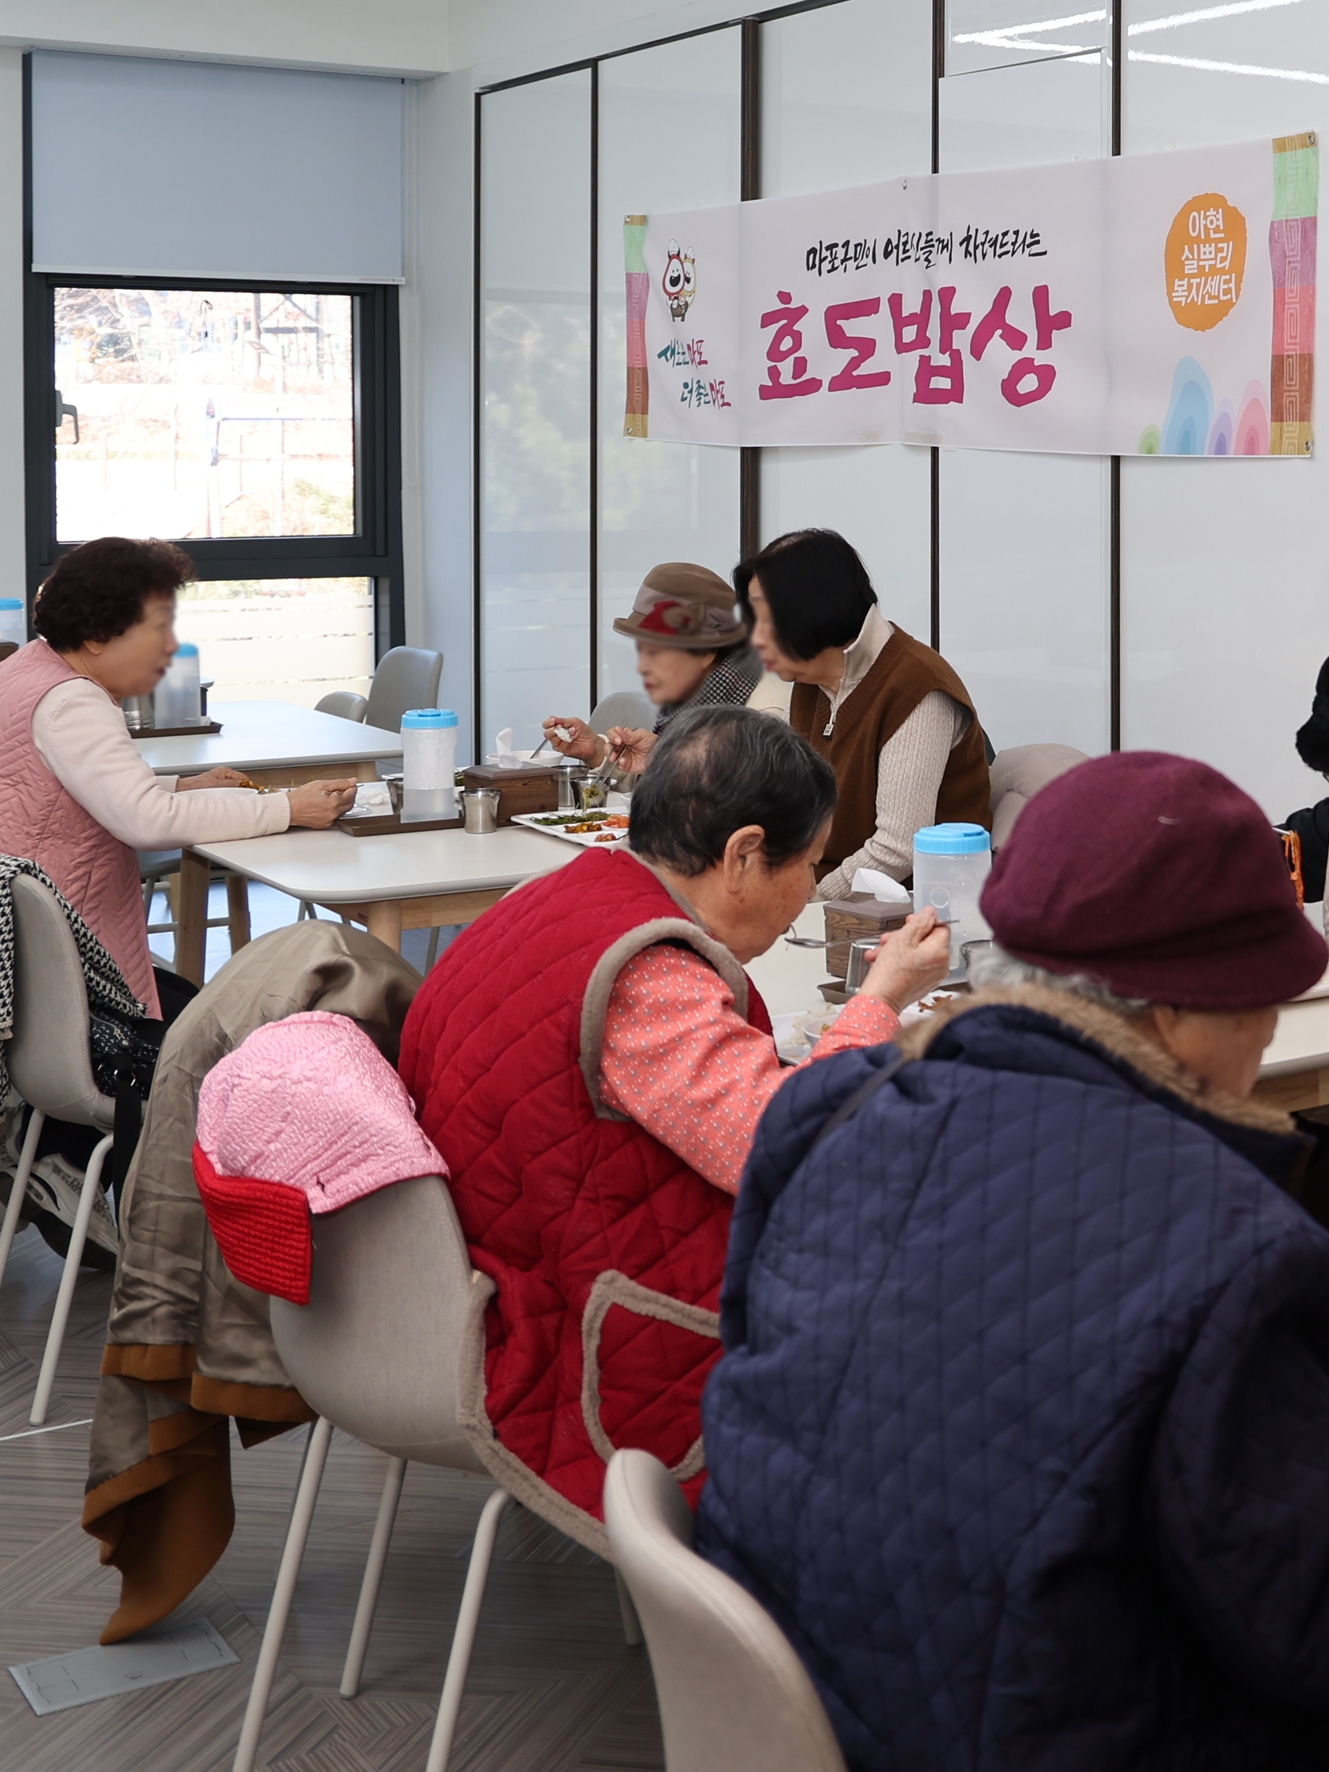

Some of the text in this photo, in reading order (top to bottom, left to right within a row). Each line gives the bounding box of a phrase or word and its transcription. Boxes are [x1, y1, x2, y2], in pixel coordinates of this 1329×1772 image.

[1189, 208, 1225, 239] 아현
[806, 224, 1048, 277] 마포구민이 어르신들께 차려드리는
[1181, 241, 1233, 274] 실뿌리
[1172, 273, 1237, 306] 복지센터
[758, 285, 1072, 408] 효도밥상
